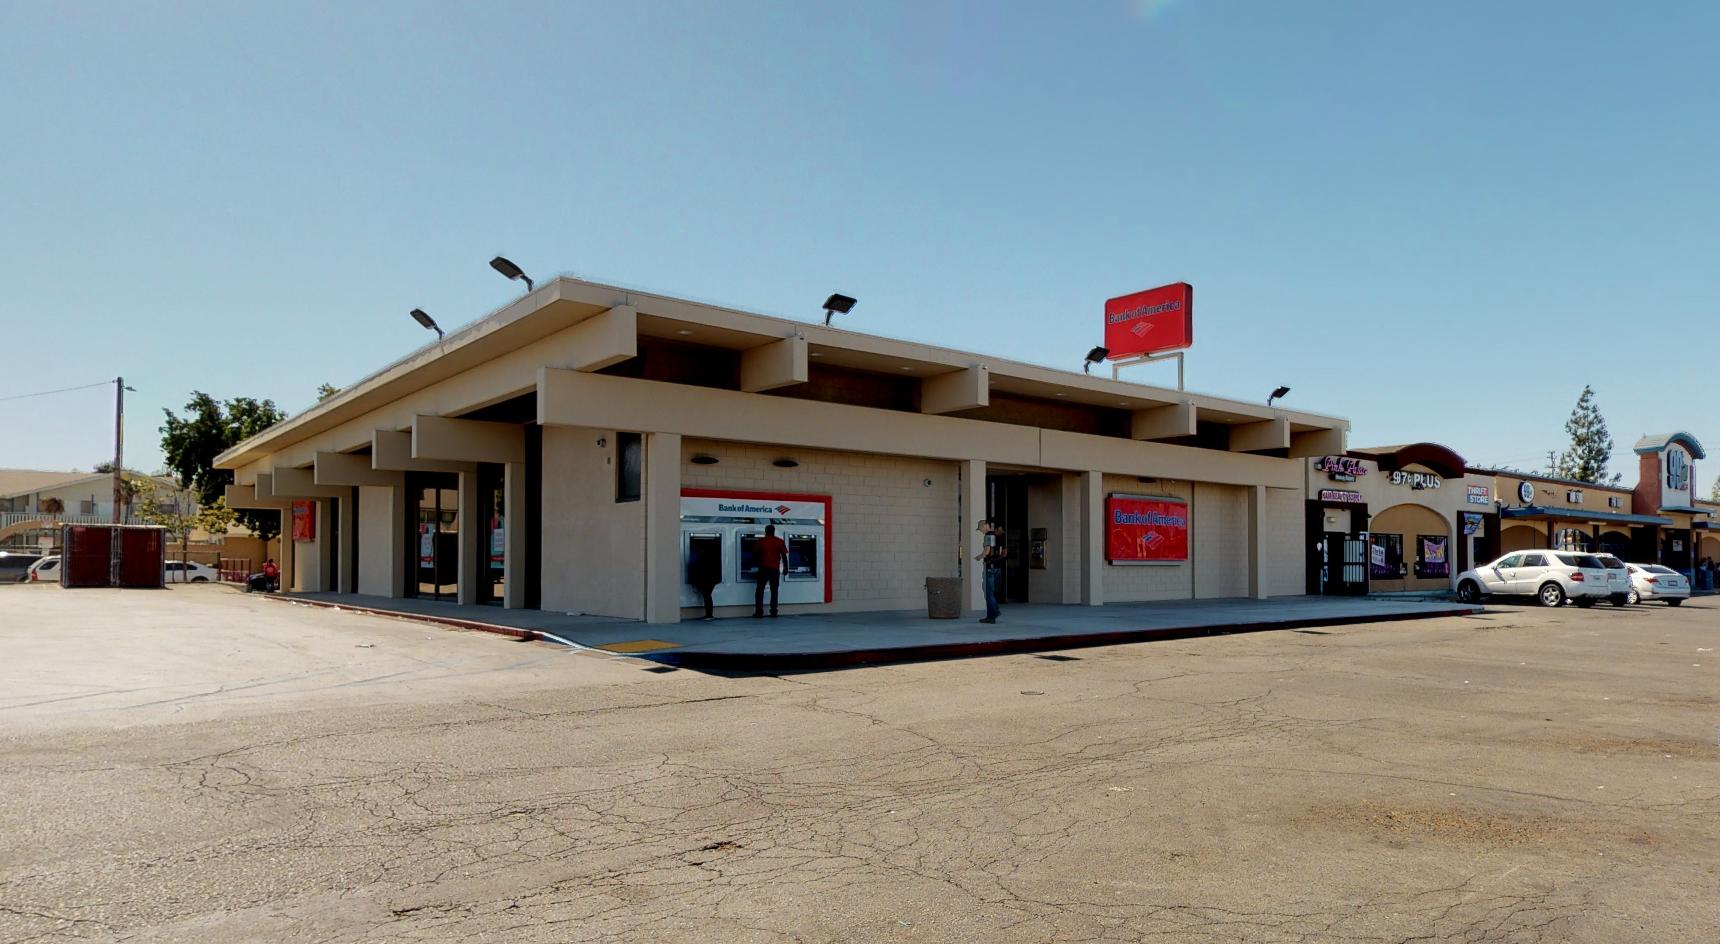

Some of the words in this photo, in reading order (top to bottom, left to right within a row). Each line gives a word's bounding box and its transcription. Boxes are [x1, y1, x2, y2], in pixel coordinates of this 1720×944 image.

[1109, 310, 1131, 323] Bank
[1131, 308, 1141, 319] of
[1142, 301, 1181, 317] America
[1413, 473, 1441, 489] PLUS
[1467, 486, 1487, 496] THRIFT
[1469, 495, 1488, 504] STORE
[719, 504, 737, 512] Bank
[737, 505, 744, 513] of
[745, 505, 773, 513] America
[1115, 510, 1140, 525] Bank
[1141, 511, 1151, 526] of
[1151, 511, 1185, 527] America
